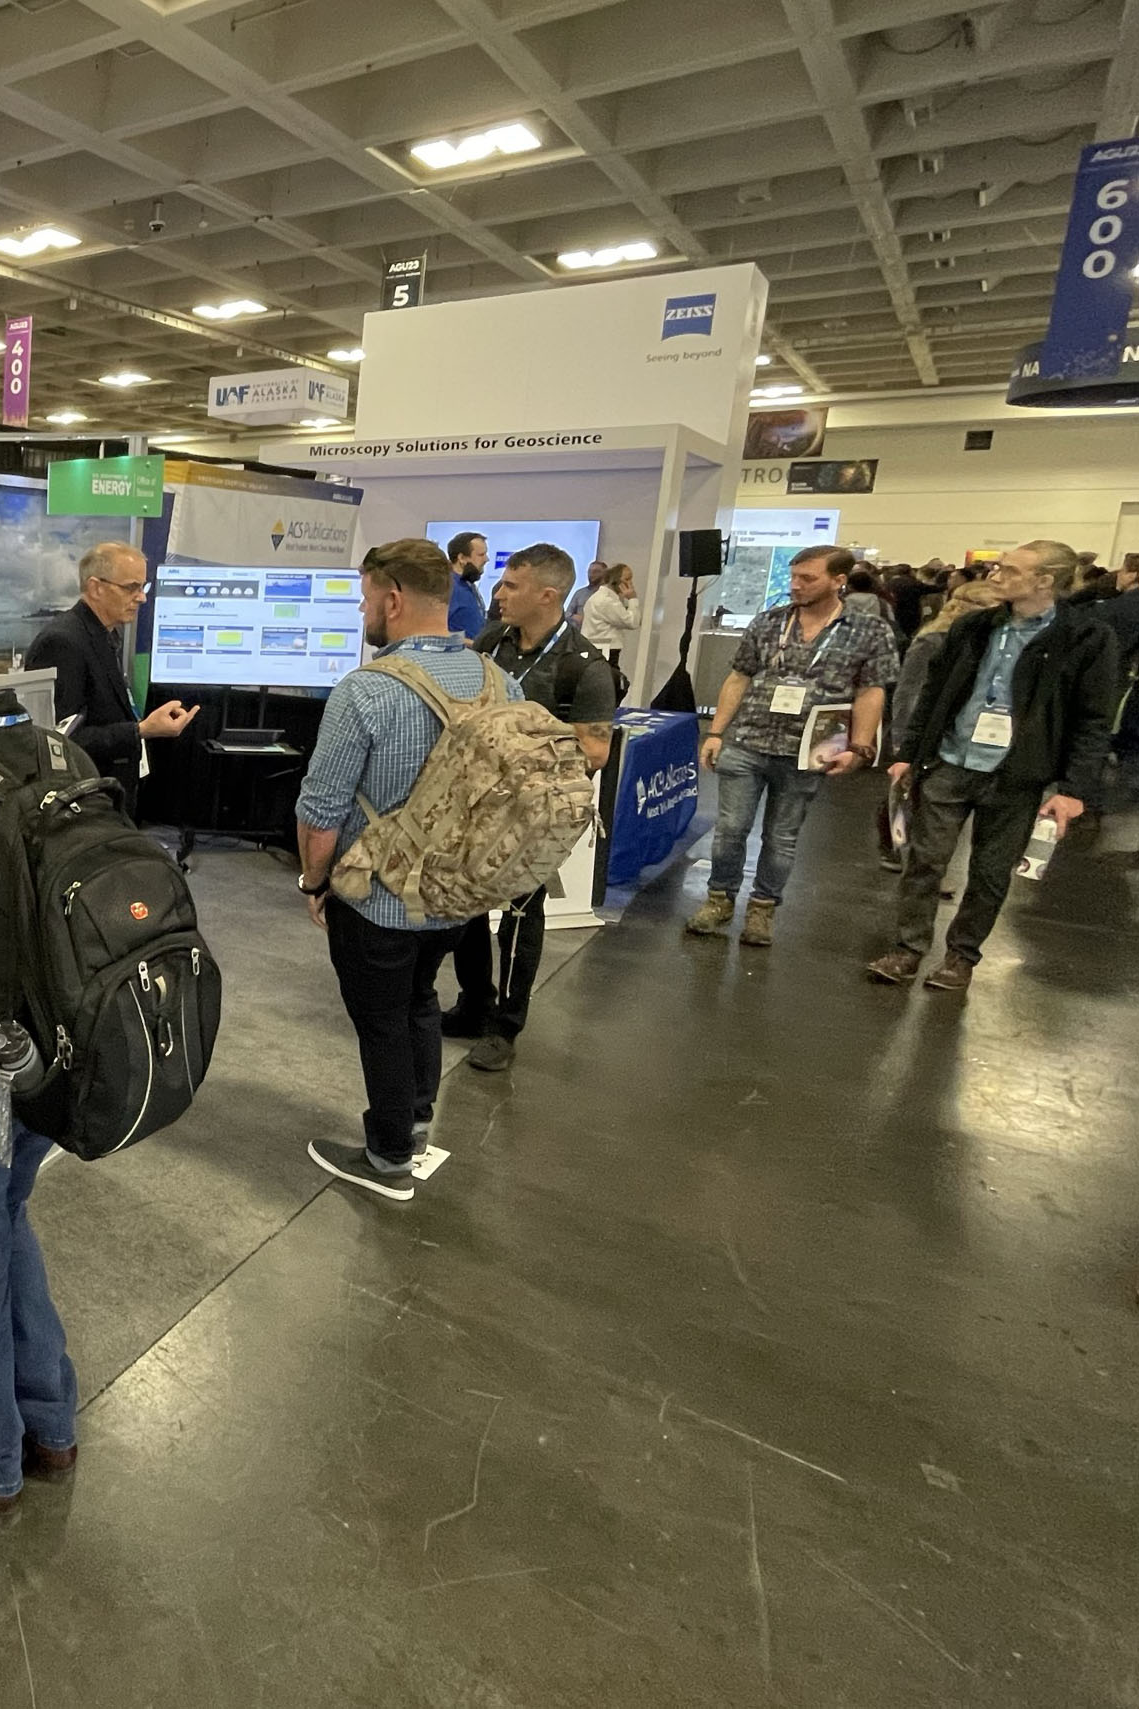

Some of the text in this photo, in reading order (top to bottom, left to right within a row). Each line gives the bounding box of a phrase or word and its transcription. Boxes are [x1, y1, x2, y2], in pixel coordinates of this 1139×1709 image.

[1082, 179, 1129, 279] 600
[389, 260, 420, 273] AGU23
[392, 284, 409, 307] 5
[665, 305, 713, 321] ZEISS
[646, 348, 722, 363] Seeing beyond
[10, 340, 24, 394] 400
[253, 386, 298, 397] ALASKA
[310, 433, 603, 457] Microscopy Solutions for Geoscience
[741, 467, 790, 484] TRO
[92, 479, 132, 496] ENERGY
[287, 521, 349, 542] ACS Publications
